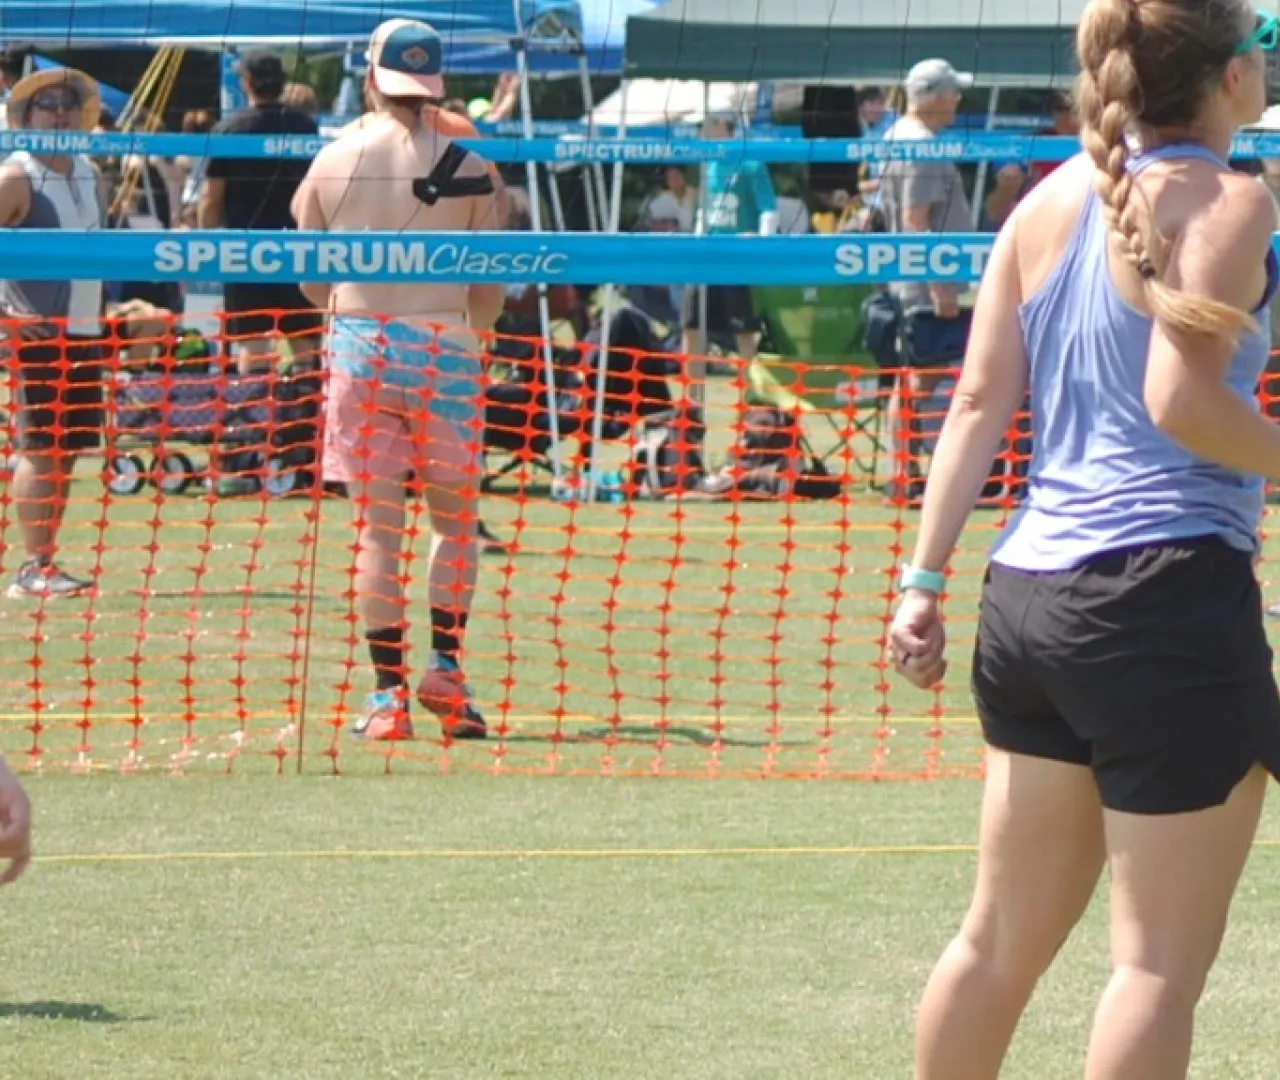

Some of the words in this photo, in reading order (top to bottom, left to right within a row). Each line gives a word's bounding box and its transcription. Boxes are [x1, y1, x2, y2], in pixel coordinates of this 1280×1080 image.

[264, 137, 329, 154] SPEC
[555, 143, 671, 159] SPECTRUM
[846, 143, 963, 159] SPECTRUM
[153, 240, 427, 274] SPECTRUM
[427, 242, 568, 276] Classic
